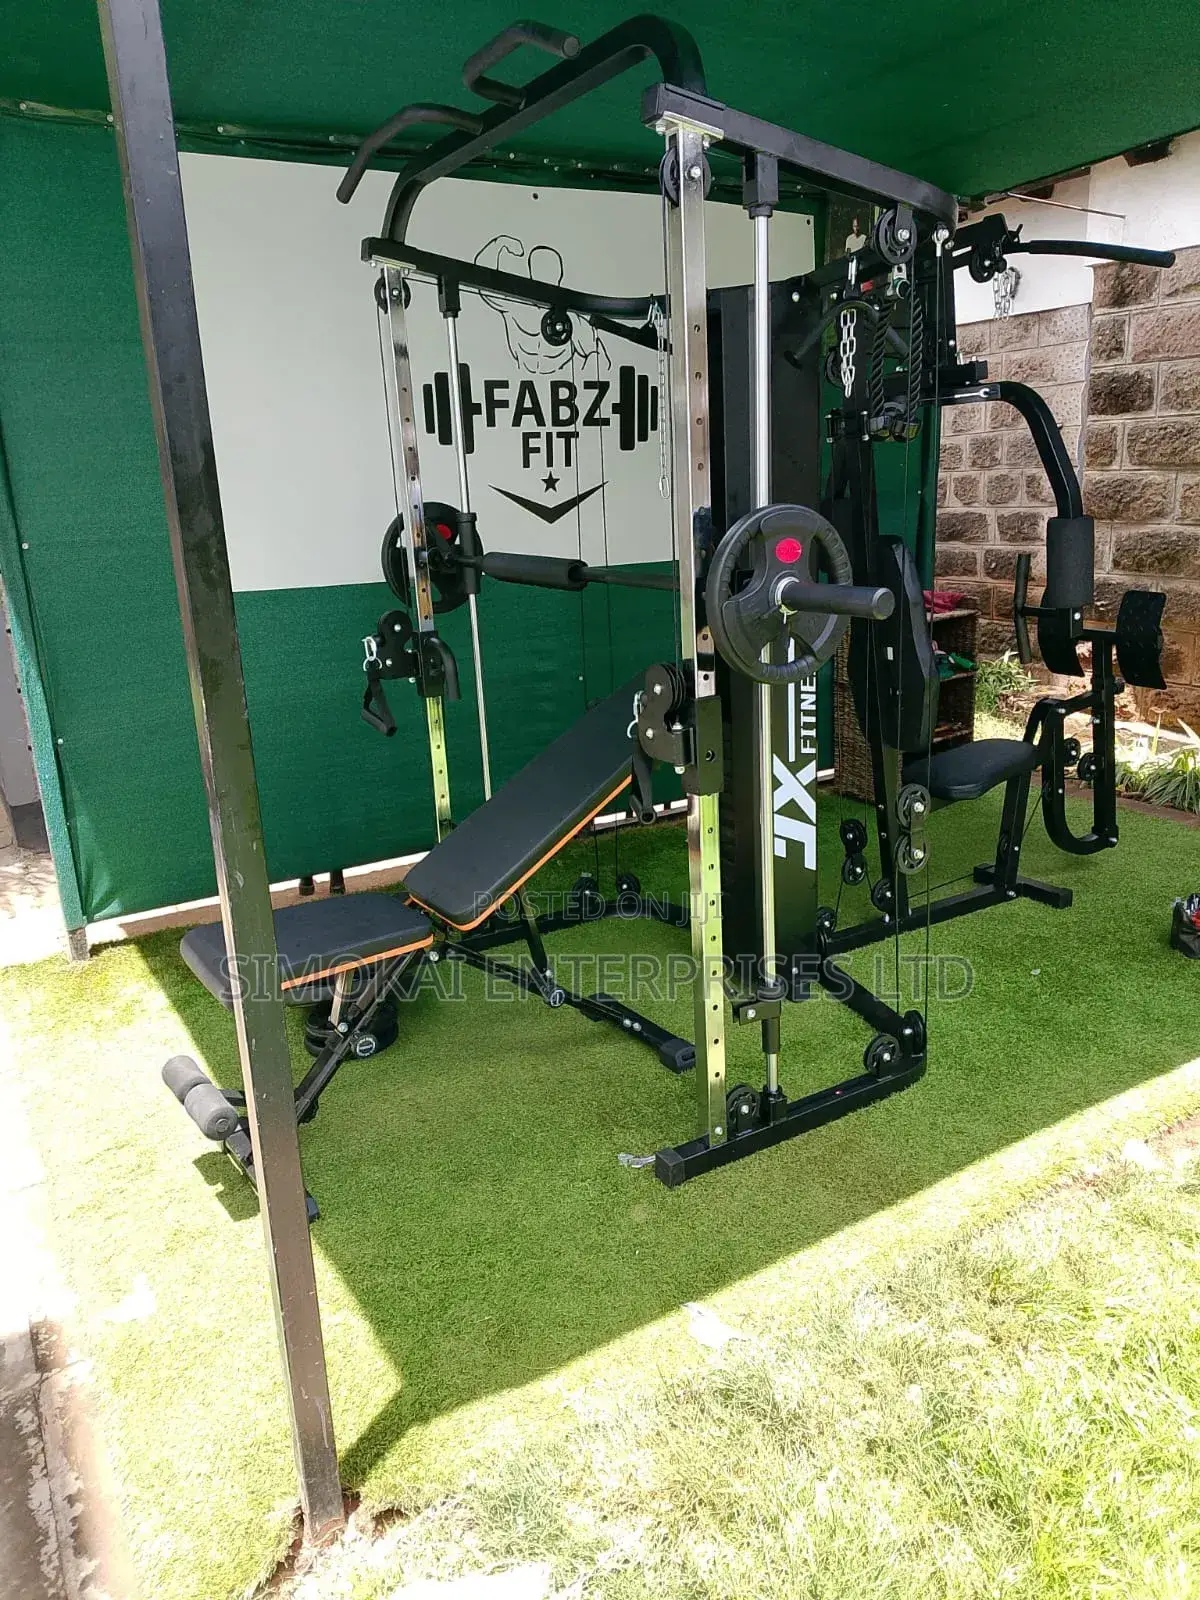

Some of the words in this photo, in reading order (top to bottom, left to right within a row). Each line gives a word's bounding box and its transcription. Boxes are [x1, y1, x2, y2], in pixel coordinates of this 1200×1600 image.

[484, 380, 611, 428] FABZ
[522, 431, 580, 469] FIT
[800, 671, 817, 755] FITNE
